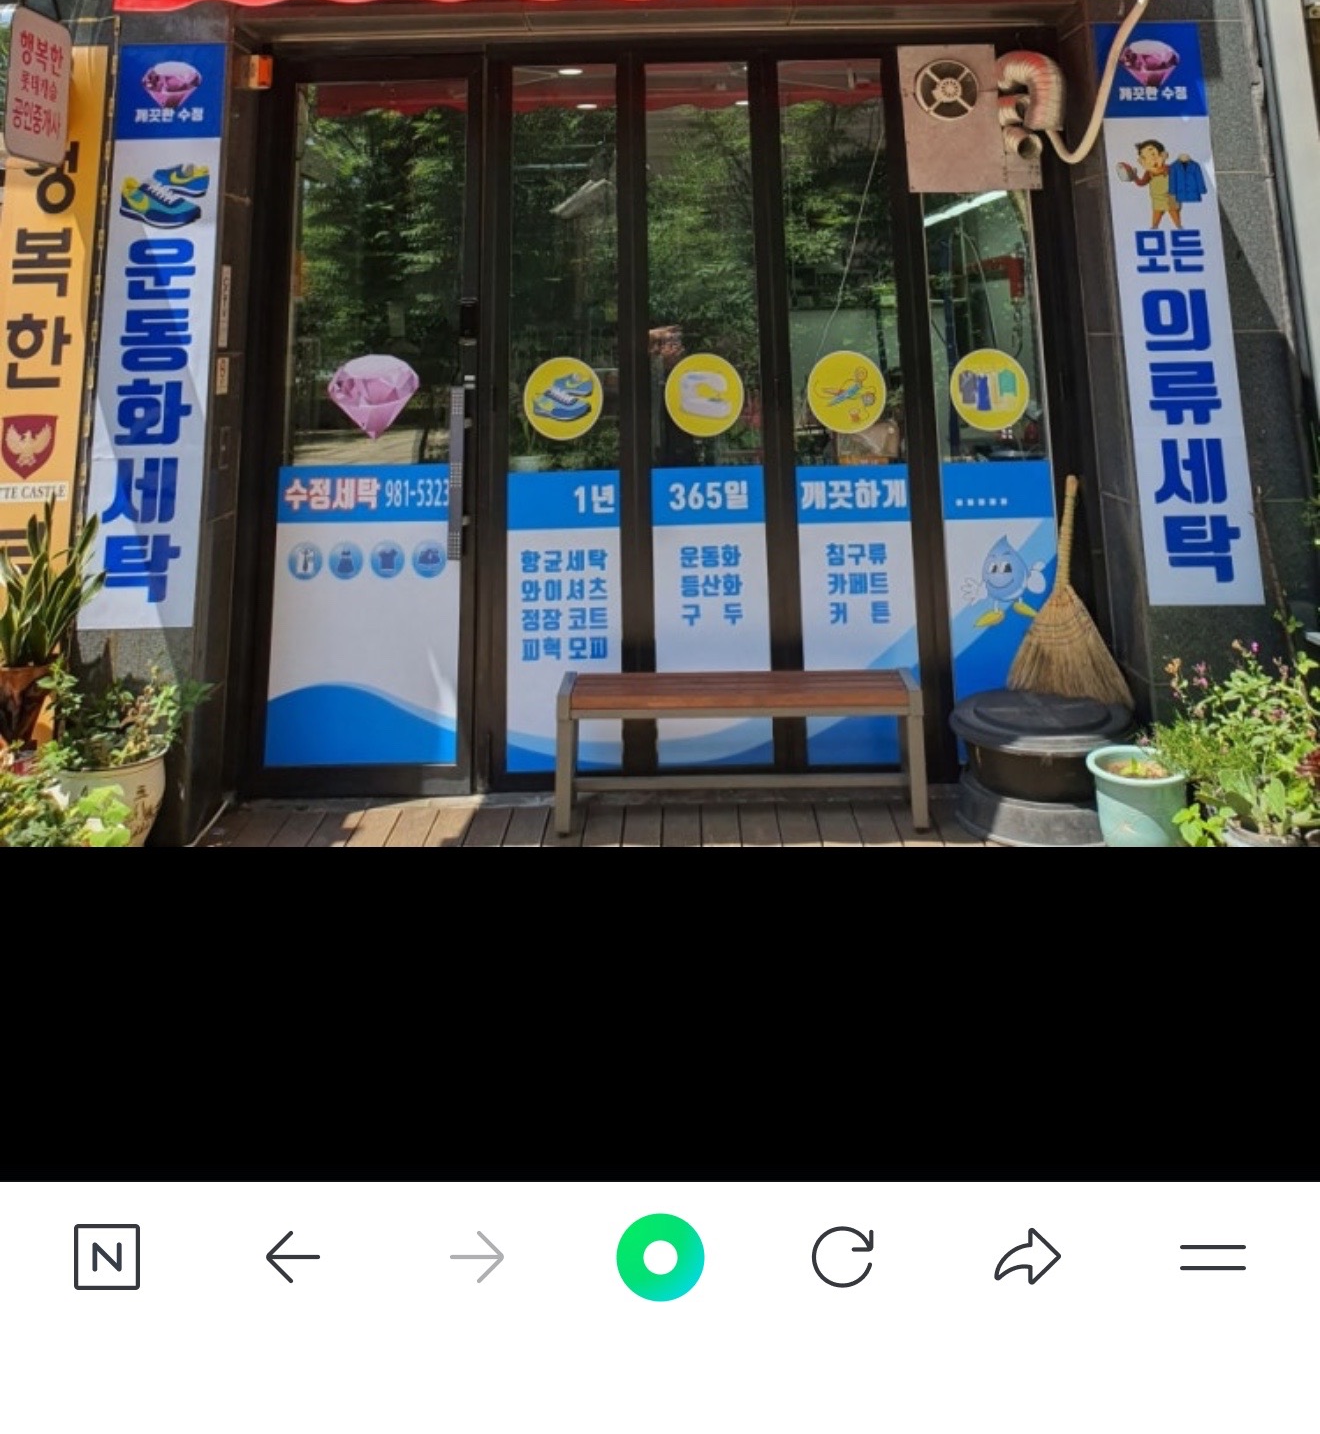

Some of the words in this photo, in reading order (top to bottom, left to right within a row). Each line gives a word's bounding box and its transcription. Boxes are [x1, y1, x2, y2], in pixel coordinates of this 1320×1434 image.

[19, 30, 64, 78] 행복한
[1161, 85, 1188, 101] 수정
[177, 107, 204, 122] 수정
[1135, 229, 1205, 273] 모든
[101, 238, 196, 603] 운동화세탁
[1141, 288, 1242, 584] 의류세탁
[284, 477, 381, 510] 수정세탁
[384, 478, 449, 508] 981-5323
[574, 484, 616, 514] 1년
[668, 480, 750, 511] 365일
[801, 478, 908, 509] 깨끗하게
[520, 549, 609, 573] 항균세탁
[679, 543, 742, 569] 운동화
[825, 542, 888, 567] 침구류
[520, 577, 609, 602] 와이셔츠
[680, 573, 743, 598] 등산화
[827, 571, 889, 596] 카페트
[521, 608, 562, 632] 정장
[568, 607, 609, 631] 코트
[521, 637, 562, 662] 피혁
[568, 637, 609, 660] 모피
